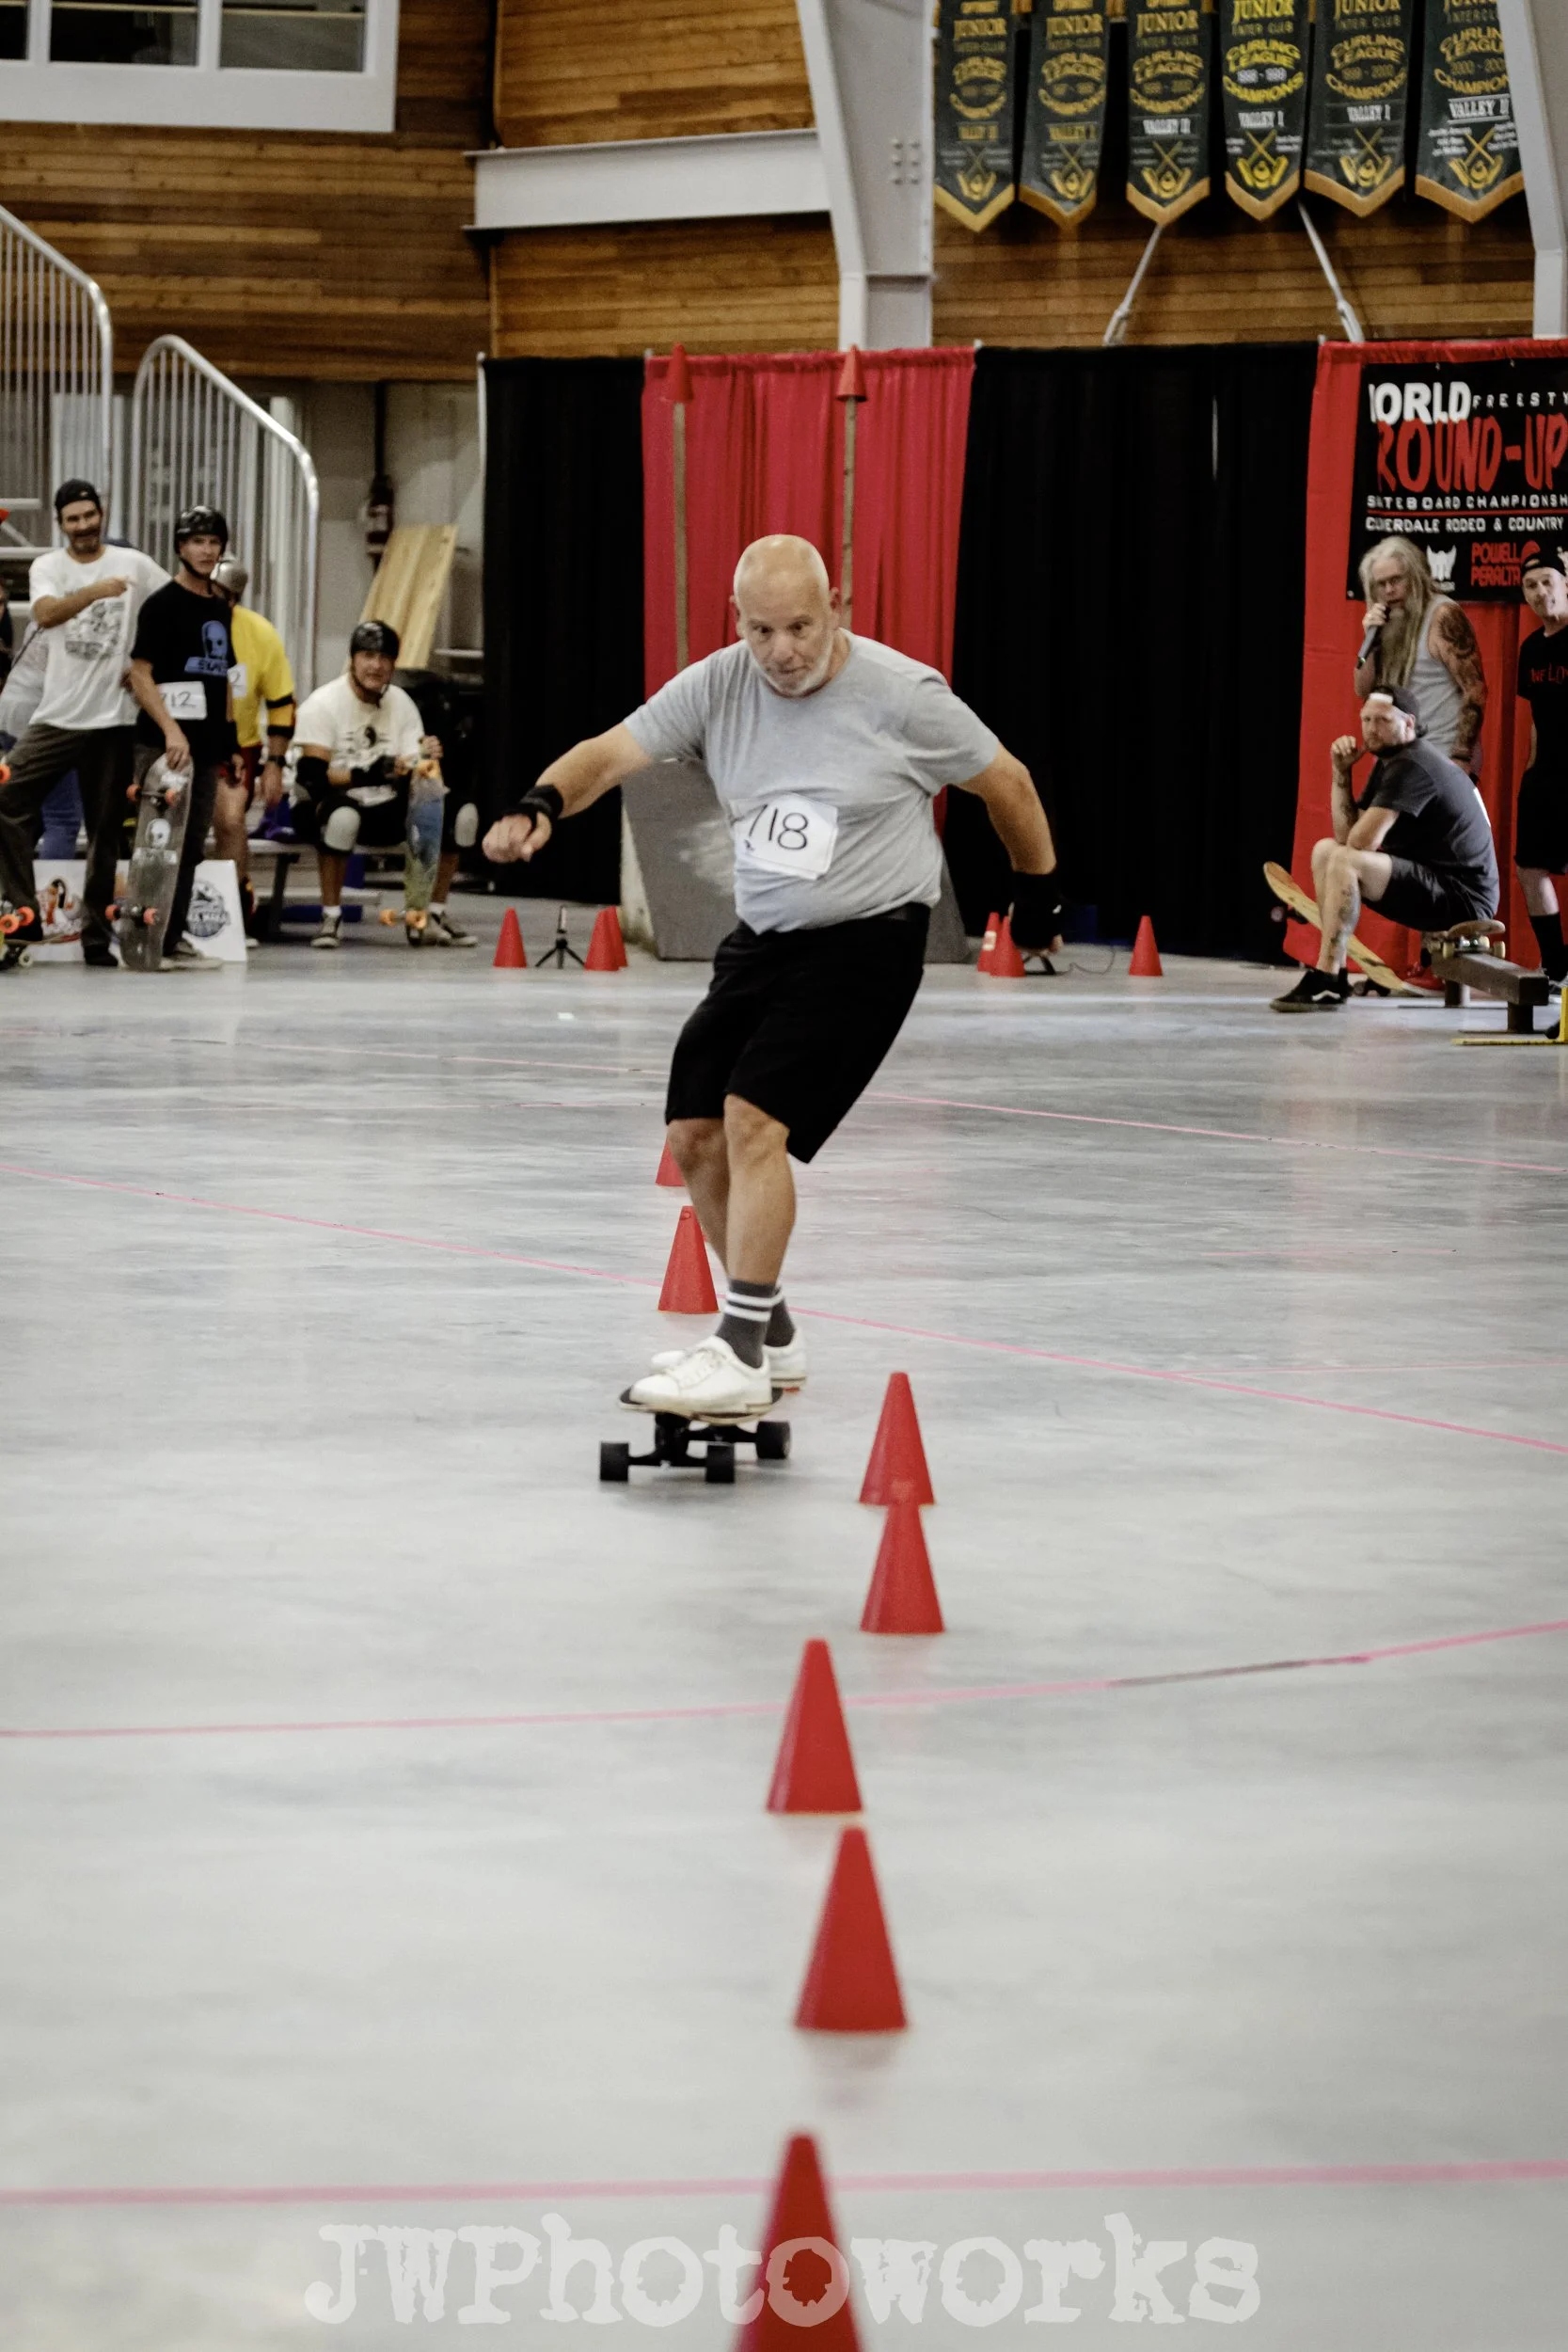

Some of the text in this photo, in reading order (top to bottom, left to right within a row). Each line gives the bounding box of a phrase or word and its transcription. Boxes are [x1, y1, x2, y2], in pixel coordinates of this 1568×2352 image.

[1136, 10, 1198, 38] JUNIOR
[1233, 0, 1294, 25] JUNIOR
[1226, 39, 1302, 61] CURLING
[1331, 34, 1405, 57] CURLING
[1439, 25, 1503, 55] CURLIN
[1445, 39, 1505, 63] LEAGU
[1228, 51, 1295, 73] LEAGUE
[1334, 46, 1402, 71] LEAGUE
[1434, 68, 1509, 95] CHAMPION
[1238, 112, 1275, 128] VALLEY
[1346, 104, 1383, 122] VALLEY
[1449, 100, 1497, 119] VALLEY
[1377, 412, 1568, 494] ROUND-UP
[1445, 518, 1486, 533] RODEO
[1508, 516, 1564, 532] COUNTRY
[1471, 542, 1521, 564] POWELL
[1470, 564, 1521, 587] PERALTA
